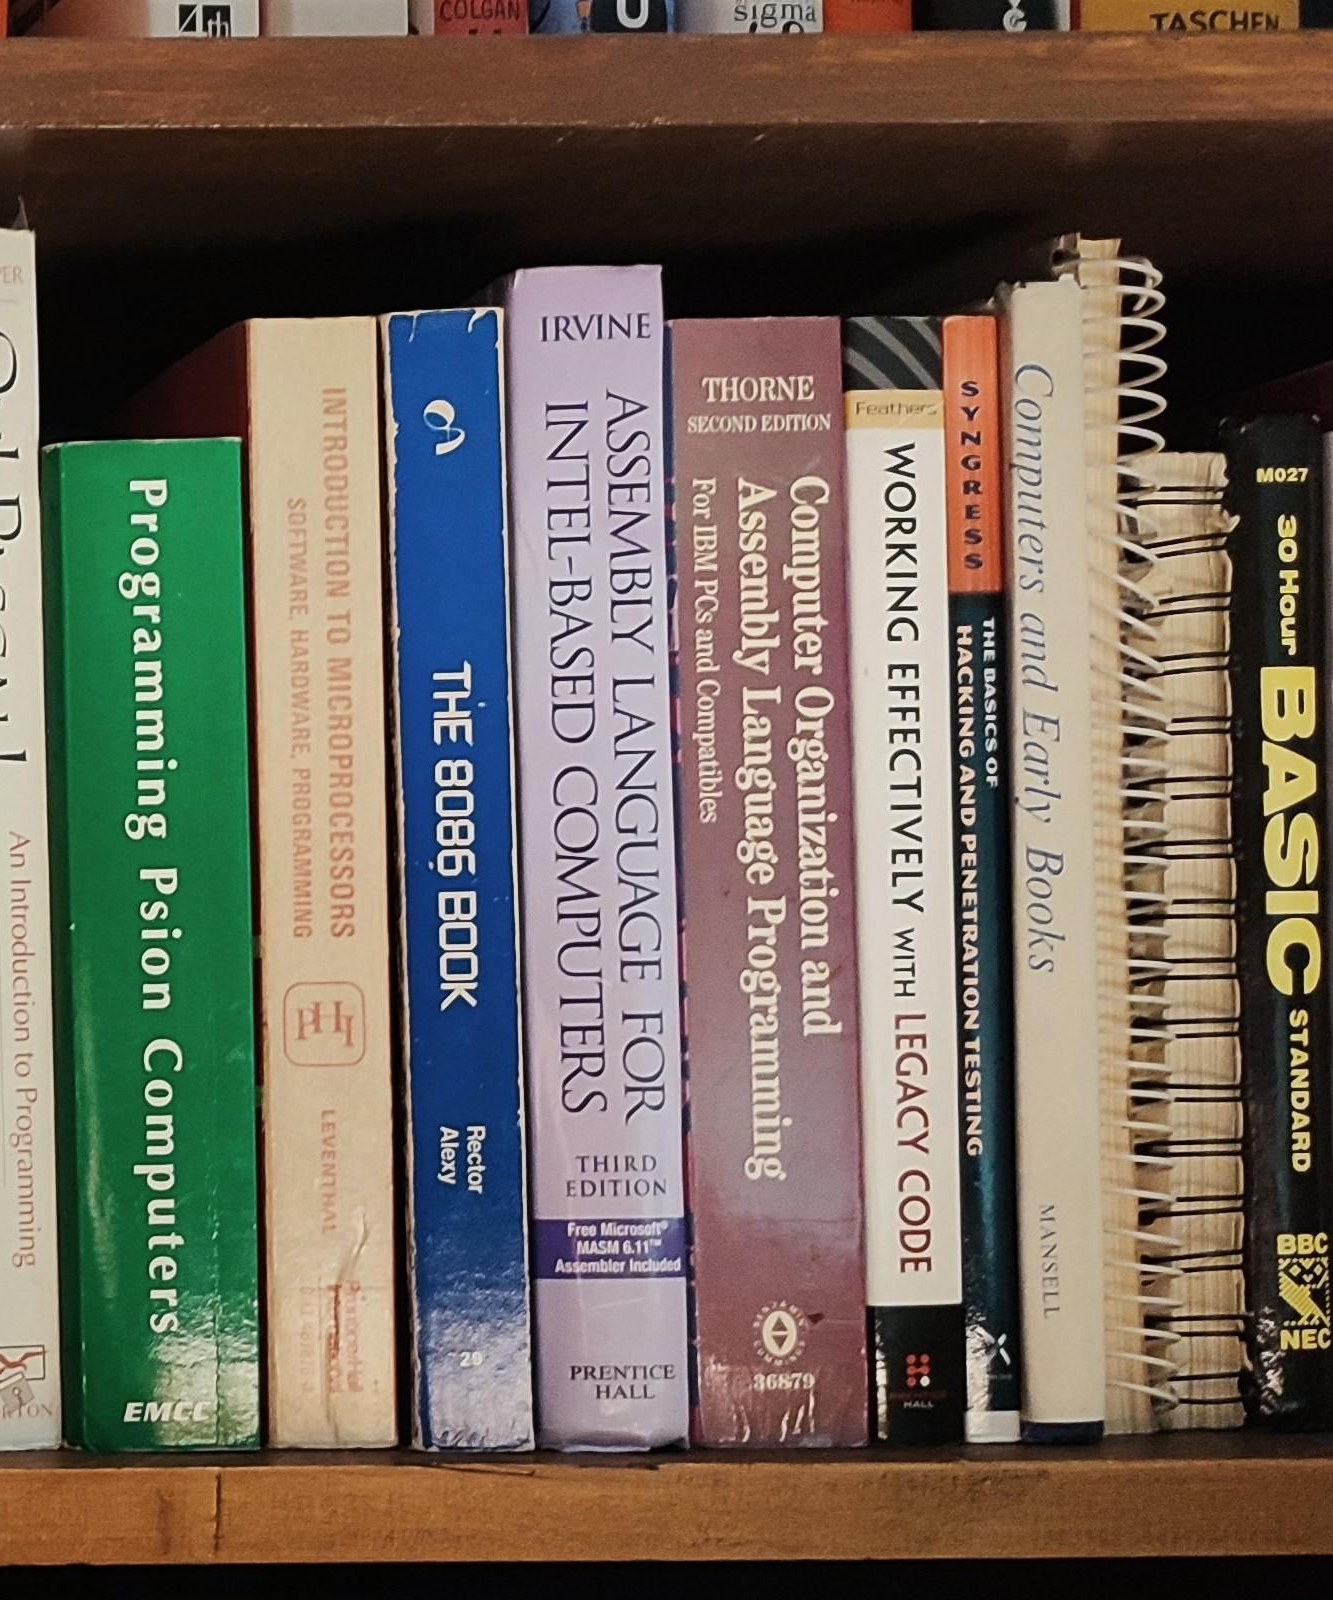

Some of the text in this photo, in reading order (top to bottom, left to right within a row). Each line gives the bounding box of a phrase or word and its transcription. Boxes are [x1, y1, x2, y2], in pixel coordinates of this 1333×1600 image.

[439, 0, 521, 22] COLGAN
[733, 3, 817, 28] sigma
[1150, 10, 1279, 32] TASCHEN
[540, 313, 652, 342] IRVINE
[702, 375, 815, 401] THORNE
[687, 413, 833, 433] SECOND EDITION
[1256, 467, 1308, 483] M027
[982, 617, 999, 789] THE BASICS OF
[544, 401, 609, 1114] INTEL-BASED COMPUTERS
[431, 660, 480, 1012] THE 8086 BOOK
[732, 477, 793, 1182] Assembly Language Programming
[1257, 515, 1321, 1173] 30 Hour BASIC STANDARD
[883, 442, 933, 1274] WORKING EFFECTIVELY WITH LEGACY CODE
[956, 624, 983, 1157] HACKING AND PENETRATION TESTING
[118, 477, 185, 1335] Programming Psion Computers
[437, 1126, 460, 1185] Alexy
[464, 1125, 487, 1194] Rector
[575, 1155, 657, 1173] THIRD
[319, 1109, 338, 1235] LEVENTHAL
[565, 1179, 667, 1198] EDITION
[570, 1364, 675, 1381] PRENTICE
[595, 1384, 655, 1400] HALL
[123, 1401, 213, 1422] EMCC
